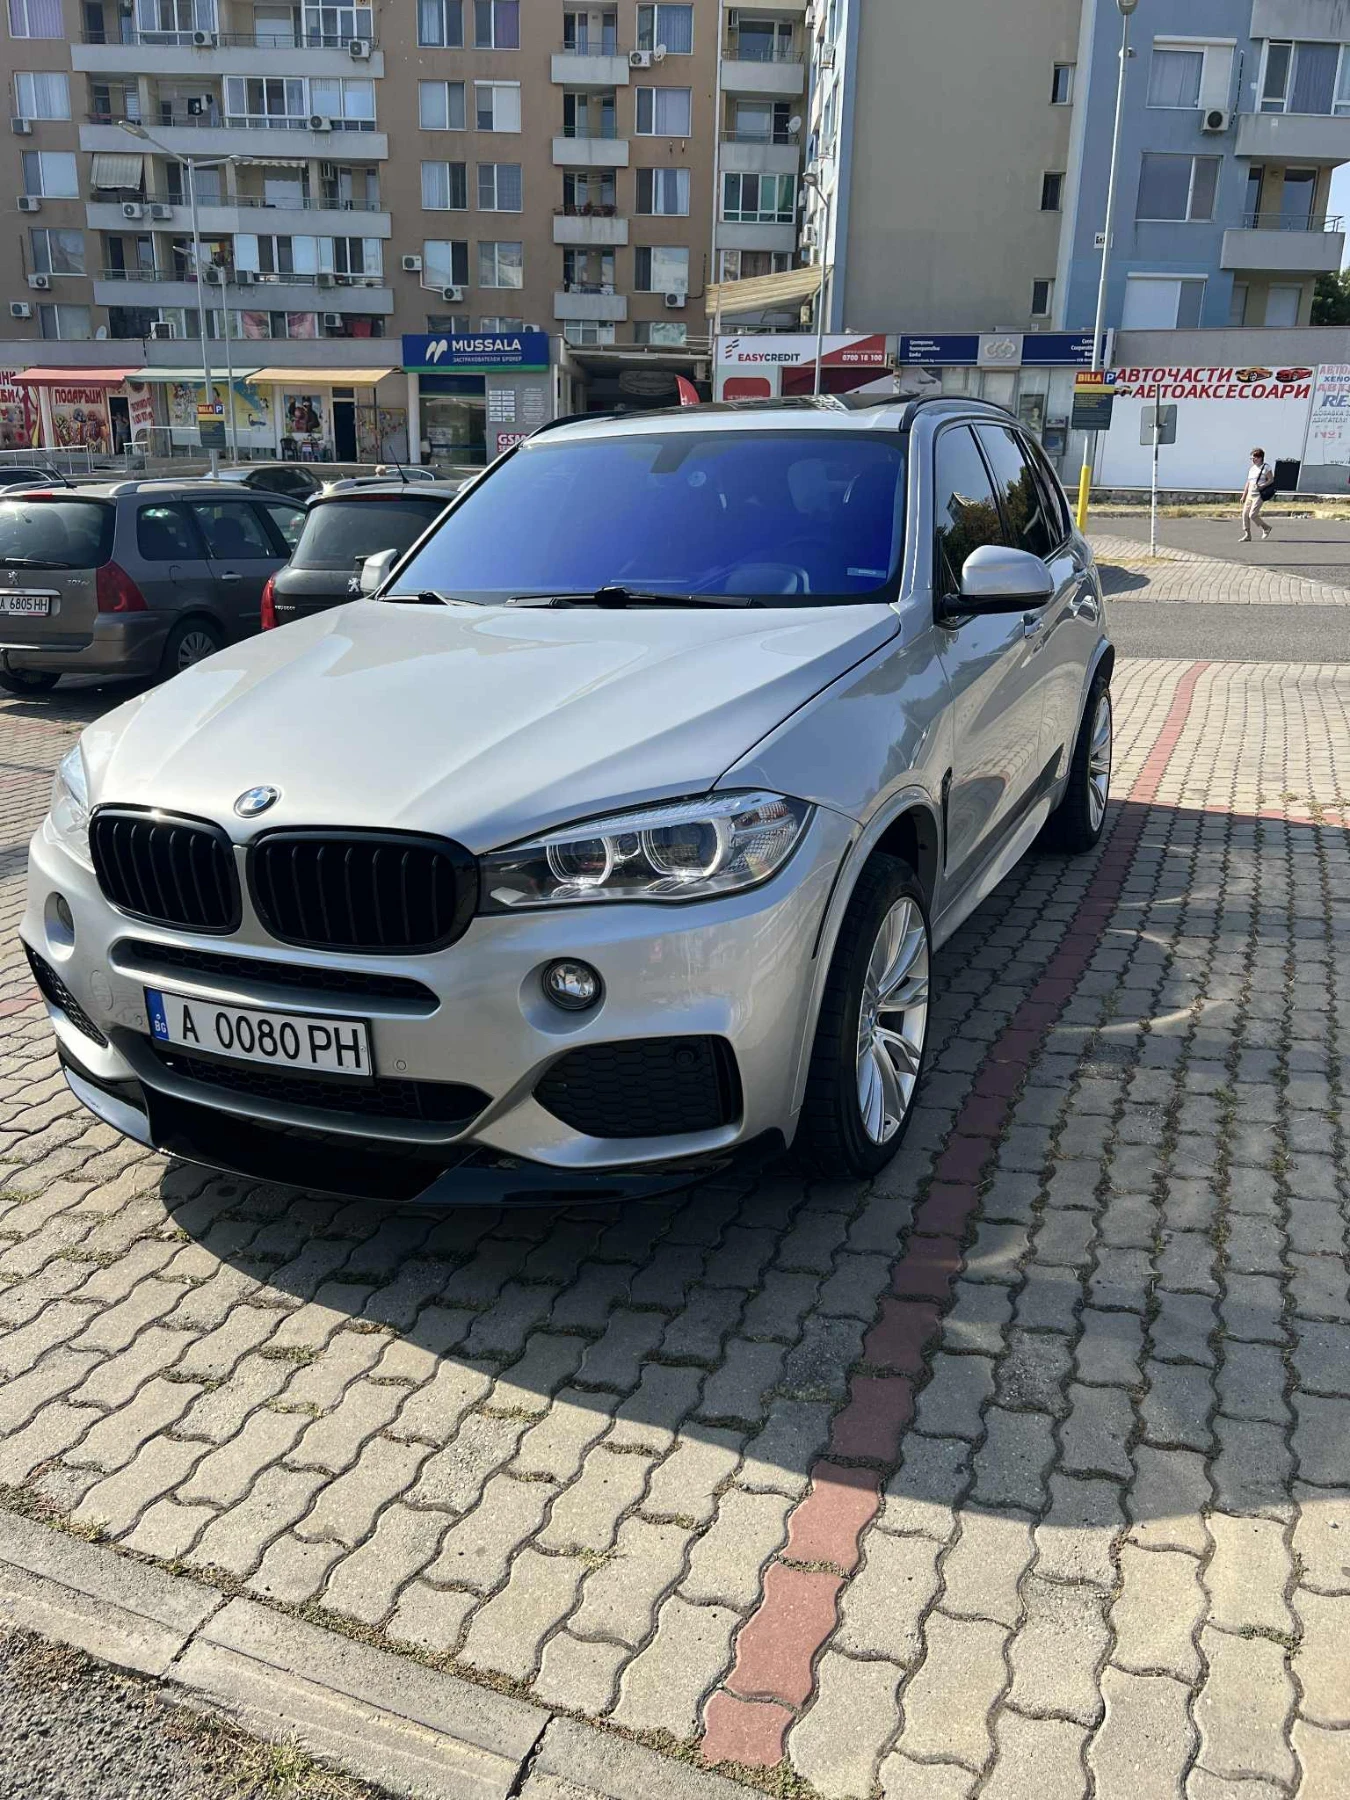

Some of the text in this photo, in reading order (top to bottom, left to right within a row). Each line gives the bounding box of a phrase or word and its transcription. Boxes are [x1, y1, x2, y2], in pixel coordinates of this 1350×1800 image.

[452, 339, 522, 351] MUSSALA
[738, 353, 801, 361] EASYCREDIT
[1077, 373, 1102, 382] BILLA
[1115, 367, 1233, 383] АВТОЧАСТИ
[1132, 384, 1310, 399] АВТОАКСЕСОАРИ
[9, 599, 32, 610] 6805
[154, 1018, 167, 1034] BG
[183, 1004, 200, 1043] A
[215, 1011, 300, 1060] 0080
